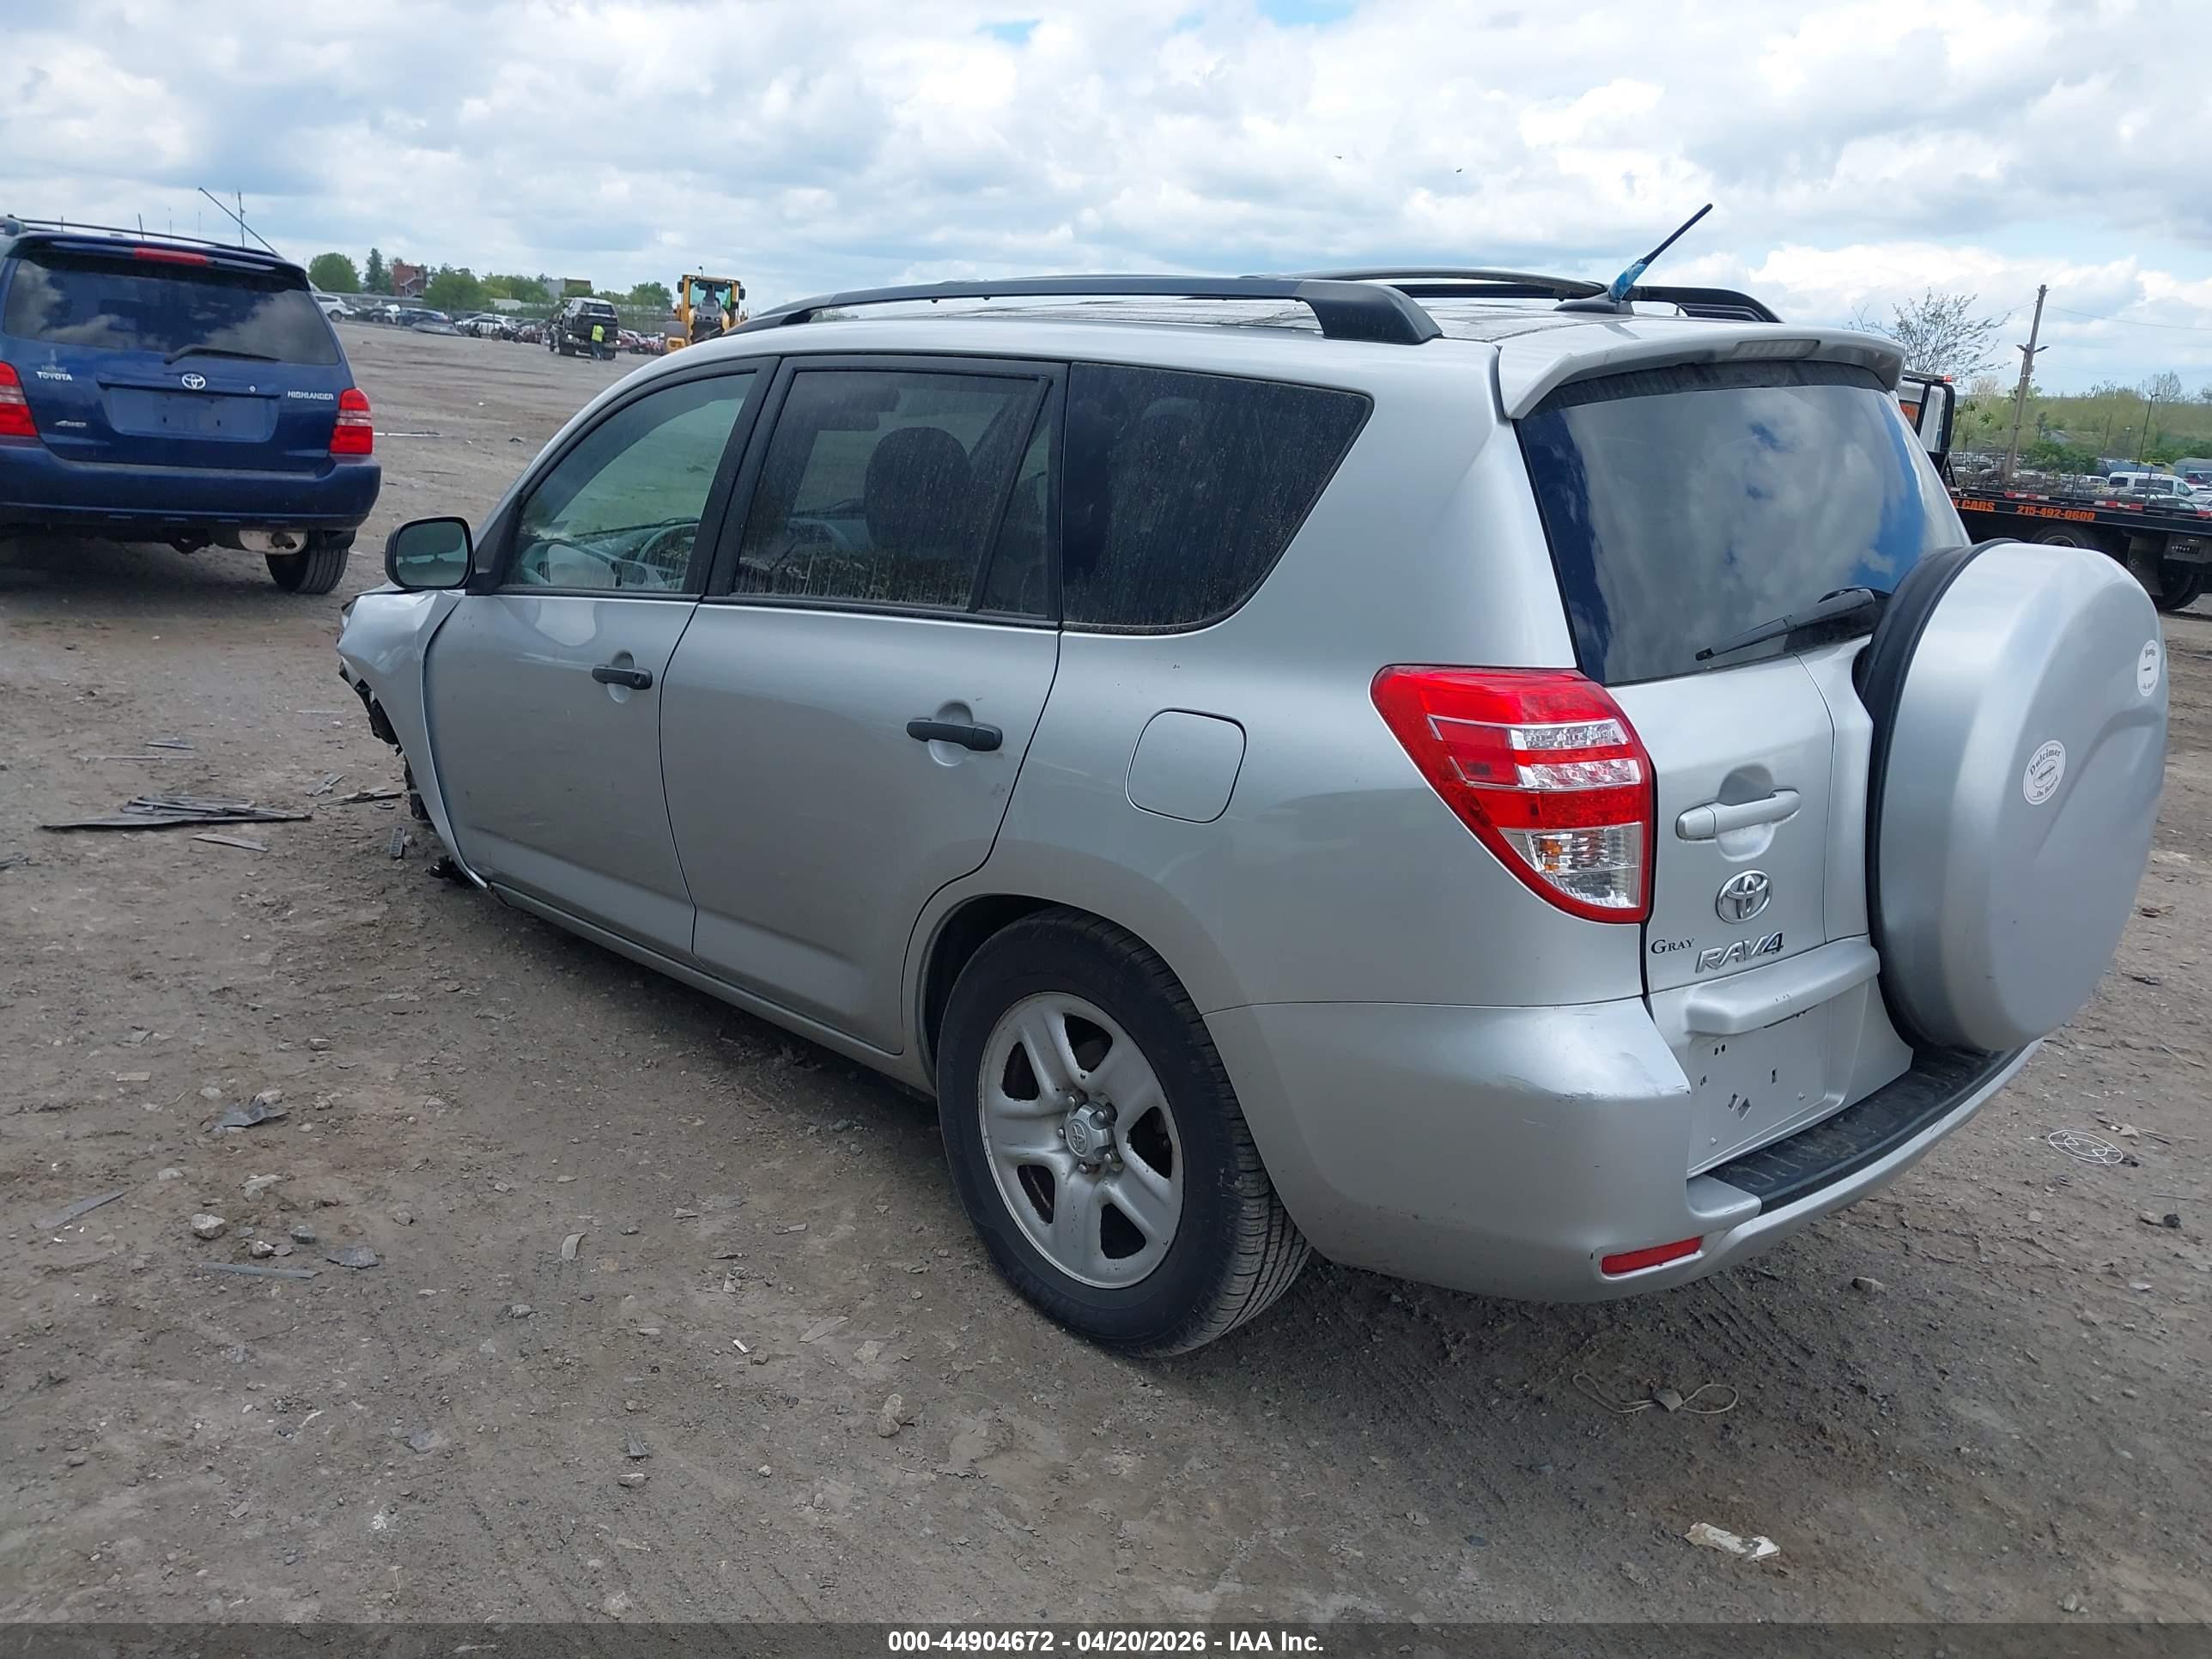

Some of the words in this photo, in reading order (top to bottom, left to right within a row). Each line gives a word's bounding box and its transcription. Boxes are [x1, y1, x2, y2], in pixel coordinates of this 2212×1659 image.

[36, 371, 73, 381] TOYOTA
[288, 391, 334, 401] HIGHLANDER
[1961, 499, 1996, 513] CARS
[2030, 748, 2061, 775] Dulcimer
[1695, 931, 1784, 974] RAV4
